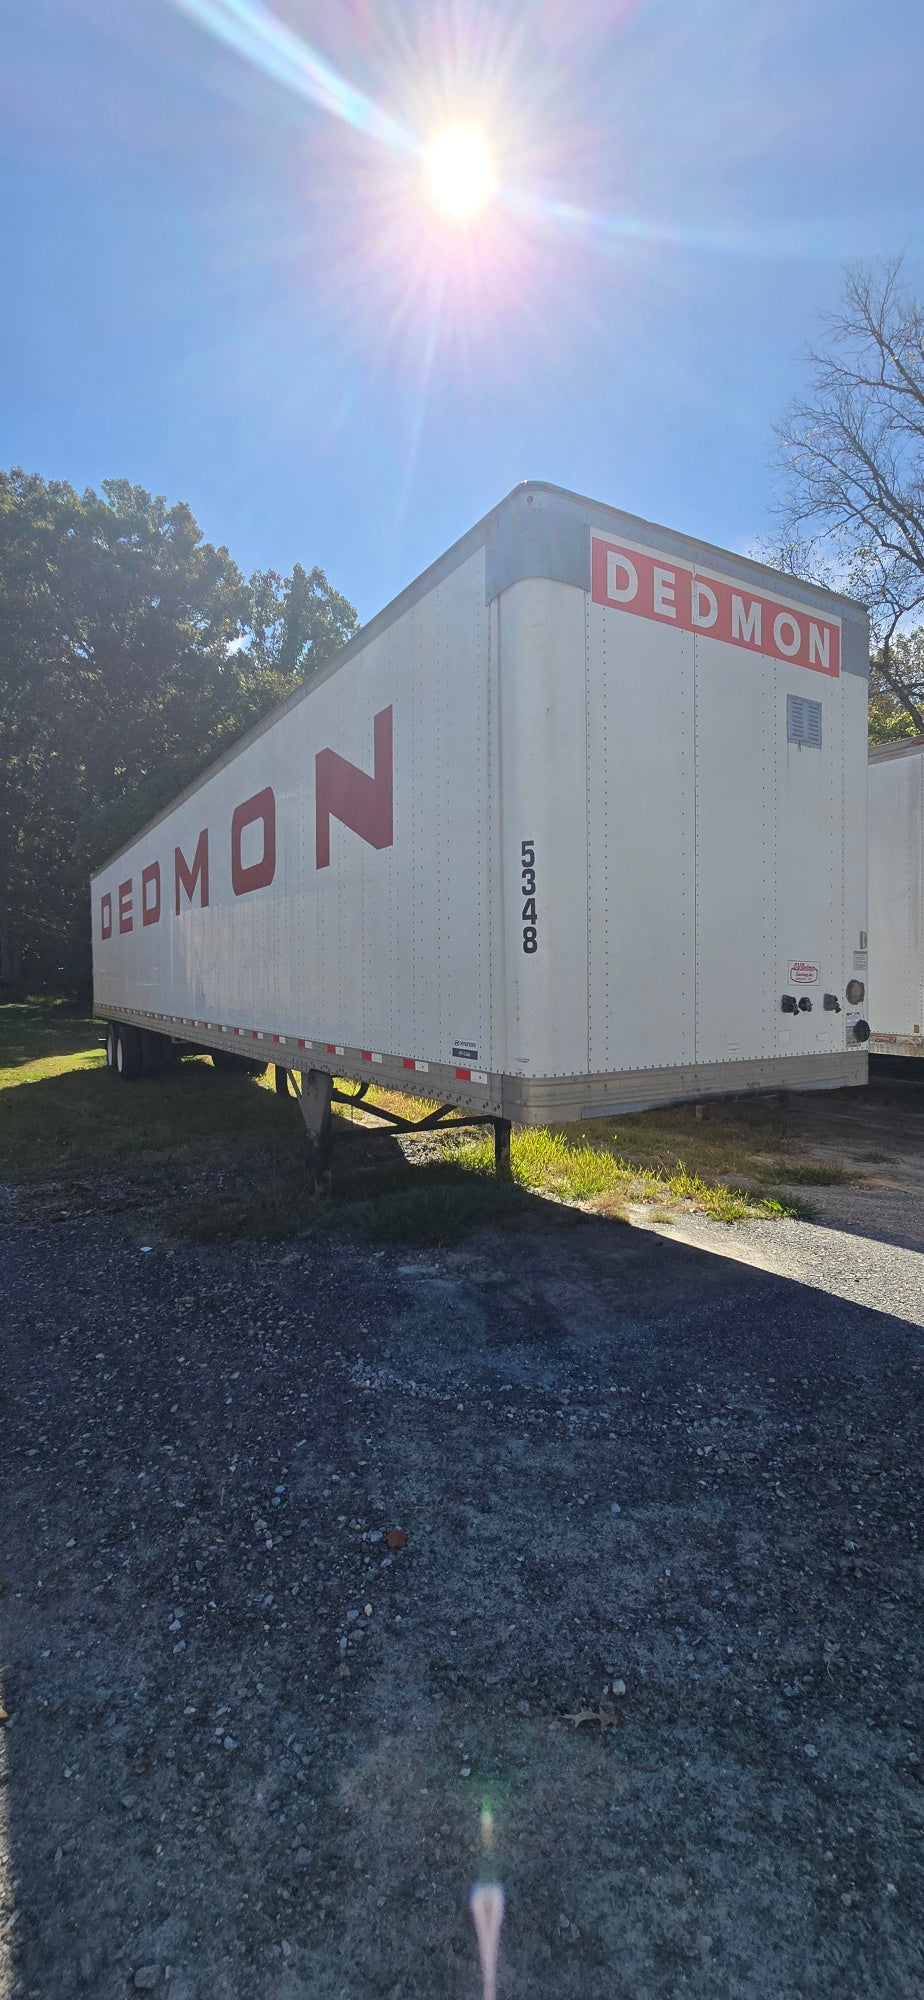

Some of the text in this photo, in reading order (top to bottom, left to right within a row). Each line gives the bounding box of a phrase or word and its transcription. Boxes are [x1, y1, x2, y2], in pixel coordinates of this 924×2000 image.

[606, 550, 830, 669] DEDMON
[100, 703, 394, 941] DEDMON
[521, 840, 538, 954] 5348
